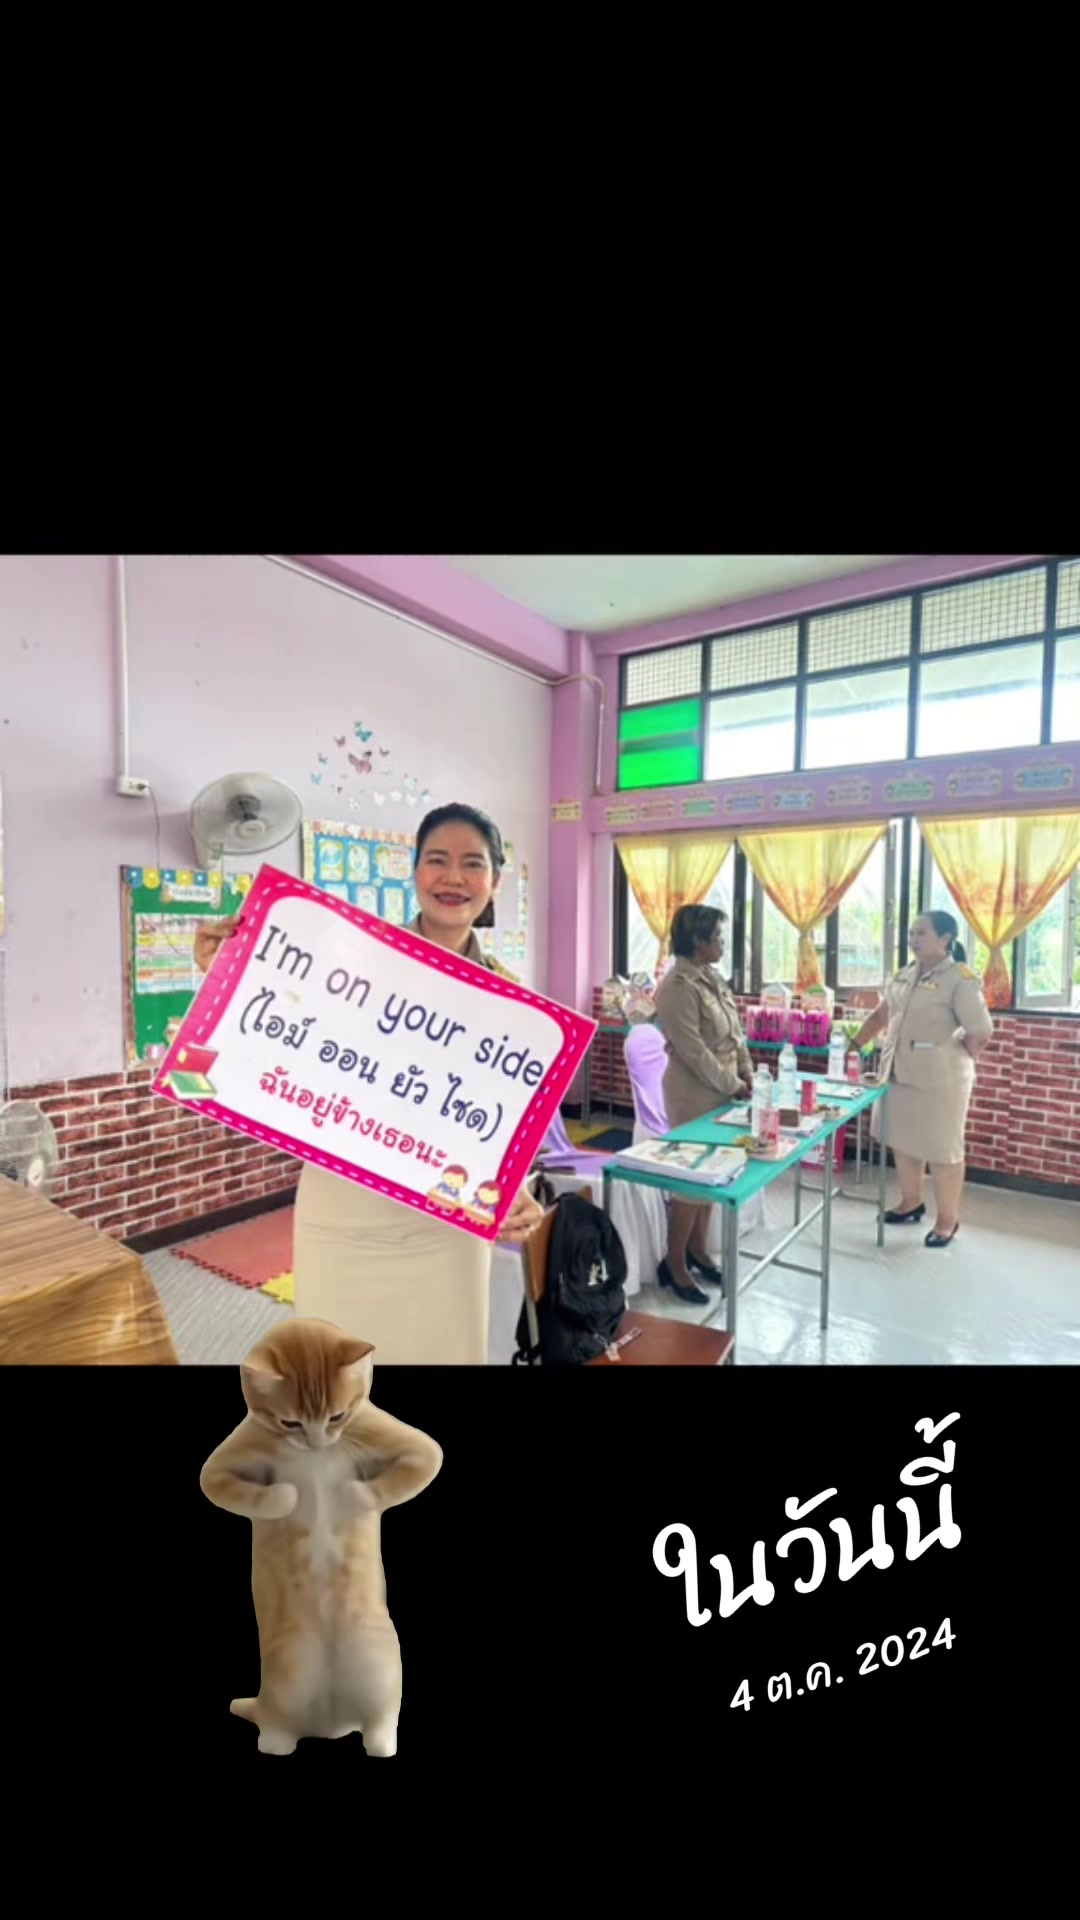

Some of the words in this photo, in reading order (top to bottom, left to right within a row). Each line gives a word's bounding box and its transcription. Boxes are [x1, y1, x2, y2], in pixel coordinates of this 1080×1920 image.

[256, 926, 313, 980] I'm
[326, 968, 371, 1007] on
[376, 993, 467, 1047] your
[239, 986, 317, 1050] (ไอม์
[318, 1039, 379, 1084] ออน
[390, 1064, 429, 1105] ยัว
[440, 1072, 503, 1143] ไซด)
[259, 1066, 448, 1168] ฉันอยู่ข้างเธอนะ
